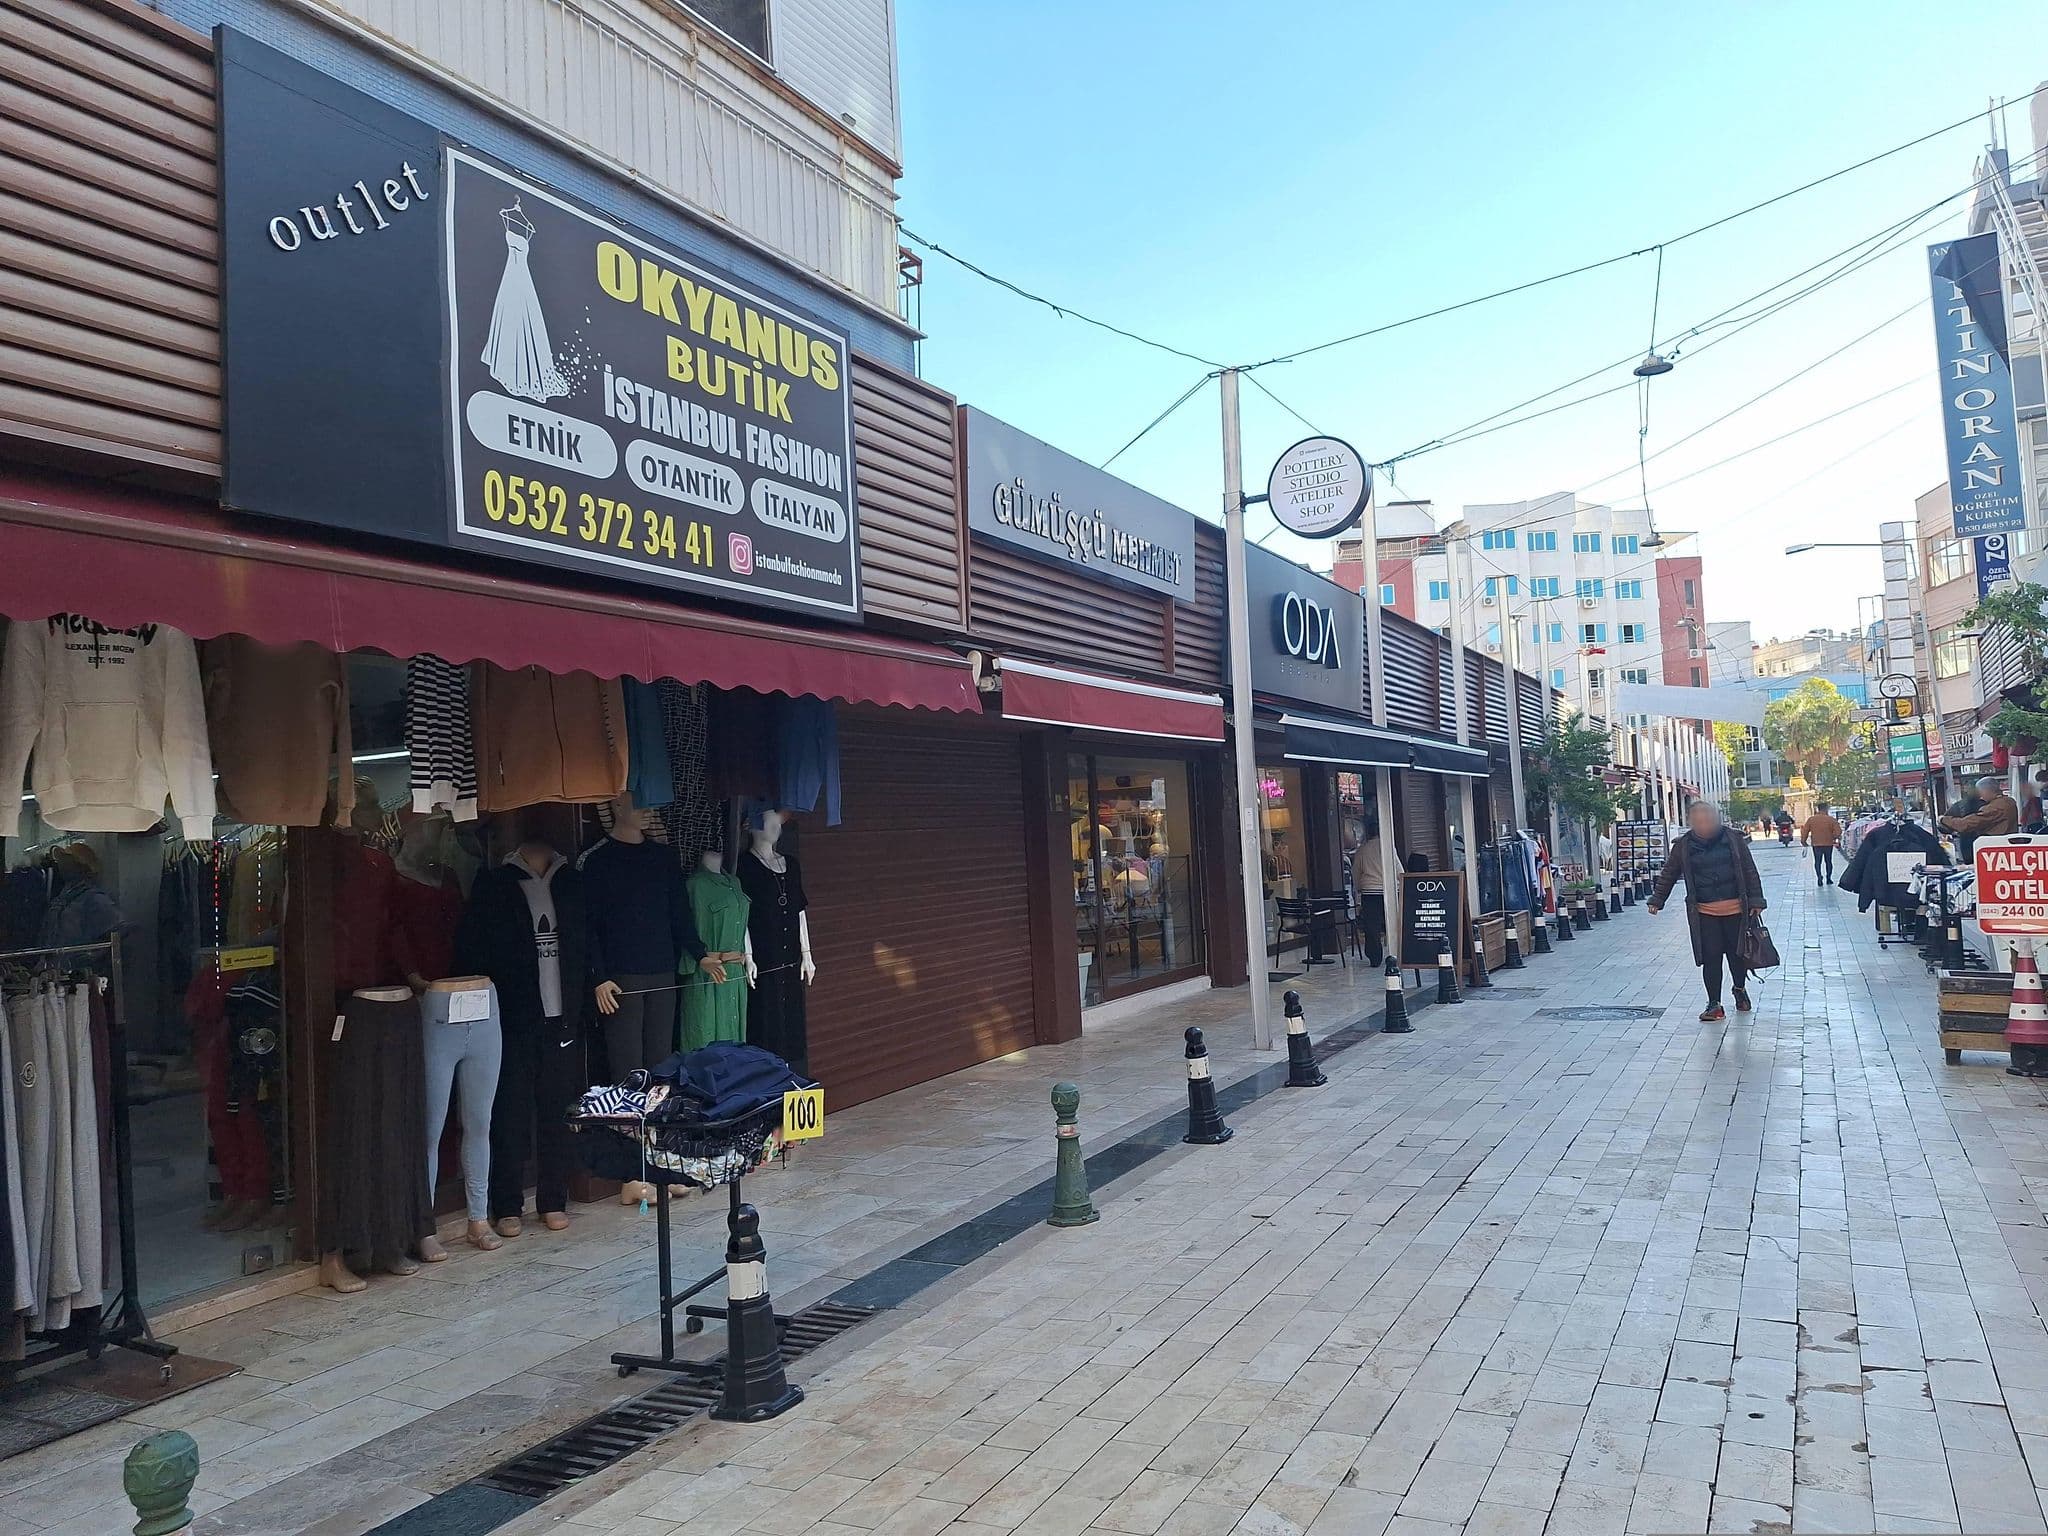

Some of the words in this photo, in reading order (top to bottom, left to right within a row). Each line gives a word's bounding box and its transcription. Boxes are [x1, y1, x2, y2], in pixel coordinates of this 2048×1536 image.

[269, 161, 429, 251] outlet
[597, 241, 839, 391] OKYANUS
[666, 335, 793, 424] BUTİK
[604, 364, 742, 459] İSTANBUL
[745, 422, 842, 492] FASHION
[508, 414, 582, 463] ETNİK
[641, 455, 732, 506] OTANTİK
[764, 485, 835, 534] İTALYAN
[1283, 453, 1345, 475] POTTERY
[1290, 470, 1341, 490] STUDIO
[1290, 485, 1344, 504] ATELIER
[1299, 503, 1335, 519] SHOP
[484, 470, 569, 536] 0532
[578, 493, 634, 550] 372
[643, 510, 677, 559] 34
[685, 521, 713, 568] 41
[993, 477, 1106, 563] GÜMÜŞÇÜ
[1111, 528, 1182, 585] MEHMET
[1965, 508, 2010, 522] KURSU
[755, 551, 842, 586] istanbulfashionmmoda
[1283, 590, 1341, 669] ODA
[1416, 881, 1446, 892] ODA
[1995, 879, 2048, 900] OTEL
[2001, 906, 2025, 917] 244
[2029, 906, 2044, 917] 00
